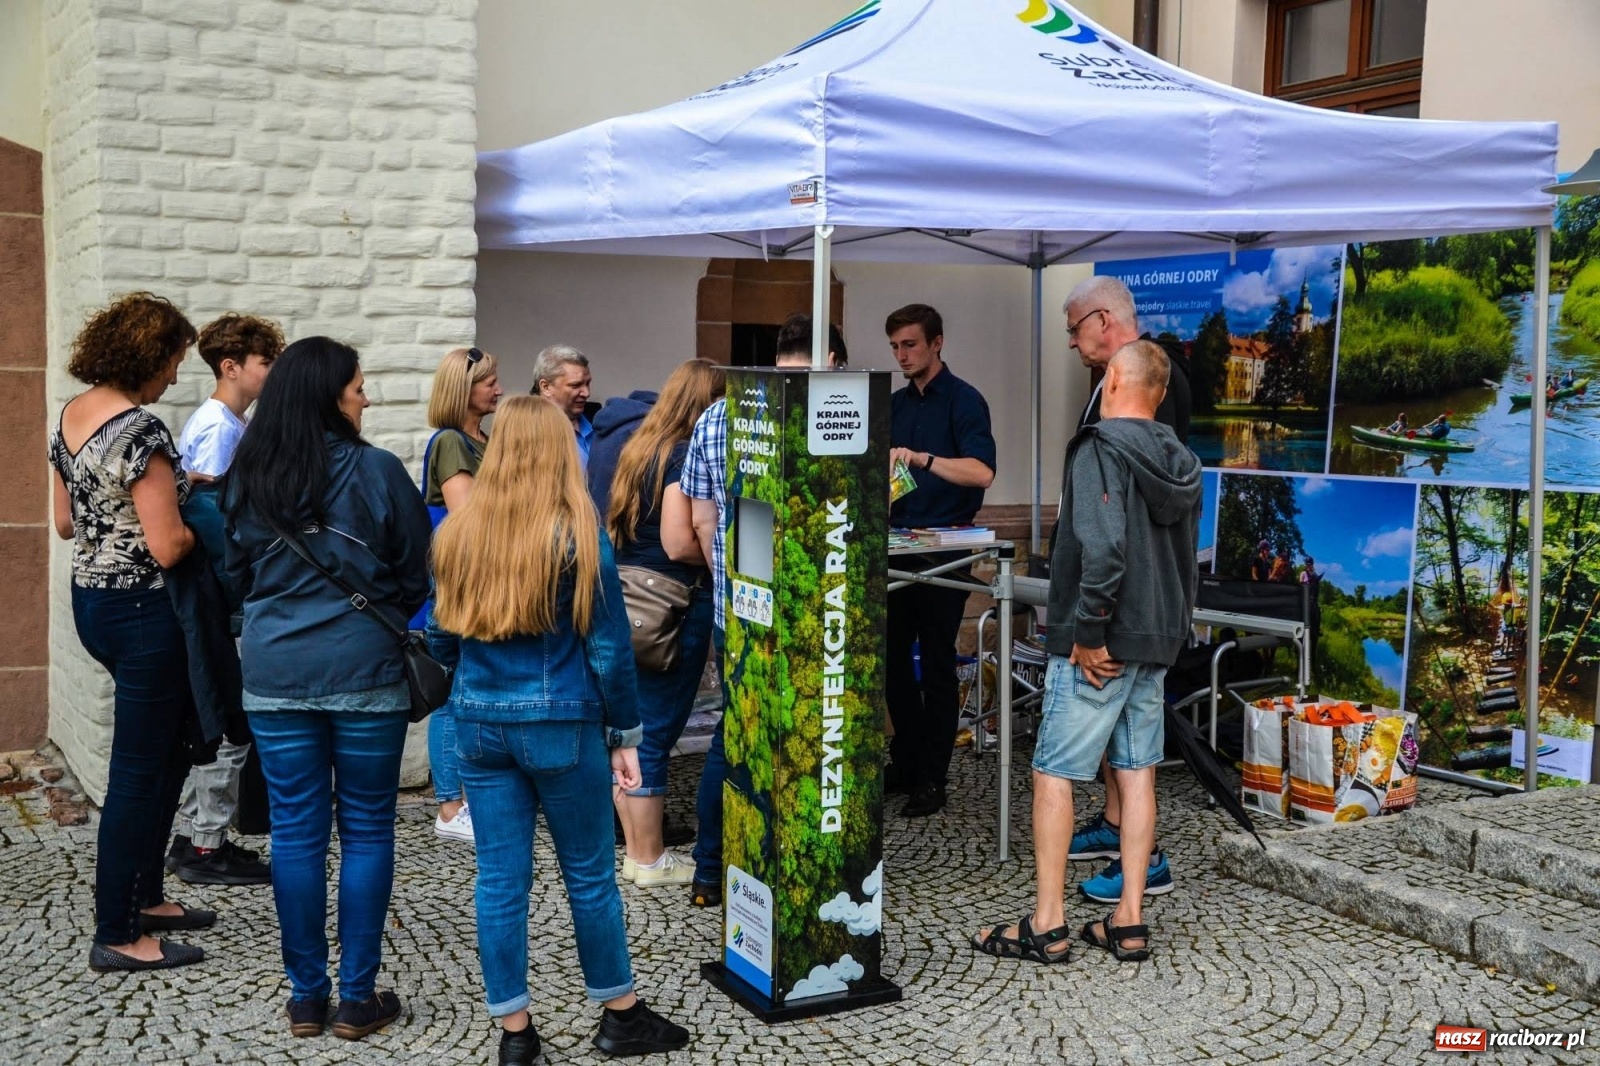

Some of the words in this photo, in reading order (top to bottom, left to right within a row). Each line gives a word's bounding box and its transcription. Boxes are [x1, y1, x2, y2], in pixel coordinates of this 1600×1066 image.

[1038, 53, 1151, 70] Subre
[1060, 67, 1168, 82] Zach
[1143, 270, 1185, 286] GÓRNEJ
[1187, 269, 1219, 283] ODRY
[816, 410, 860, 419] KRAINA
[733, 417, 775, 436] KRAINA
[815, 419, 861, 430] GÓRNEJ
[822, 432, 854, 441] ODRY
[733, 437, 776, 457] GÓRNEJ
[739, 460, 769, 477] ODRY
[825, 498, 854, 574] RĄK
[821, 583, 846, 834] DEZYNFEKCJA
